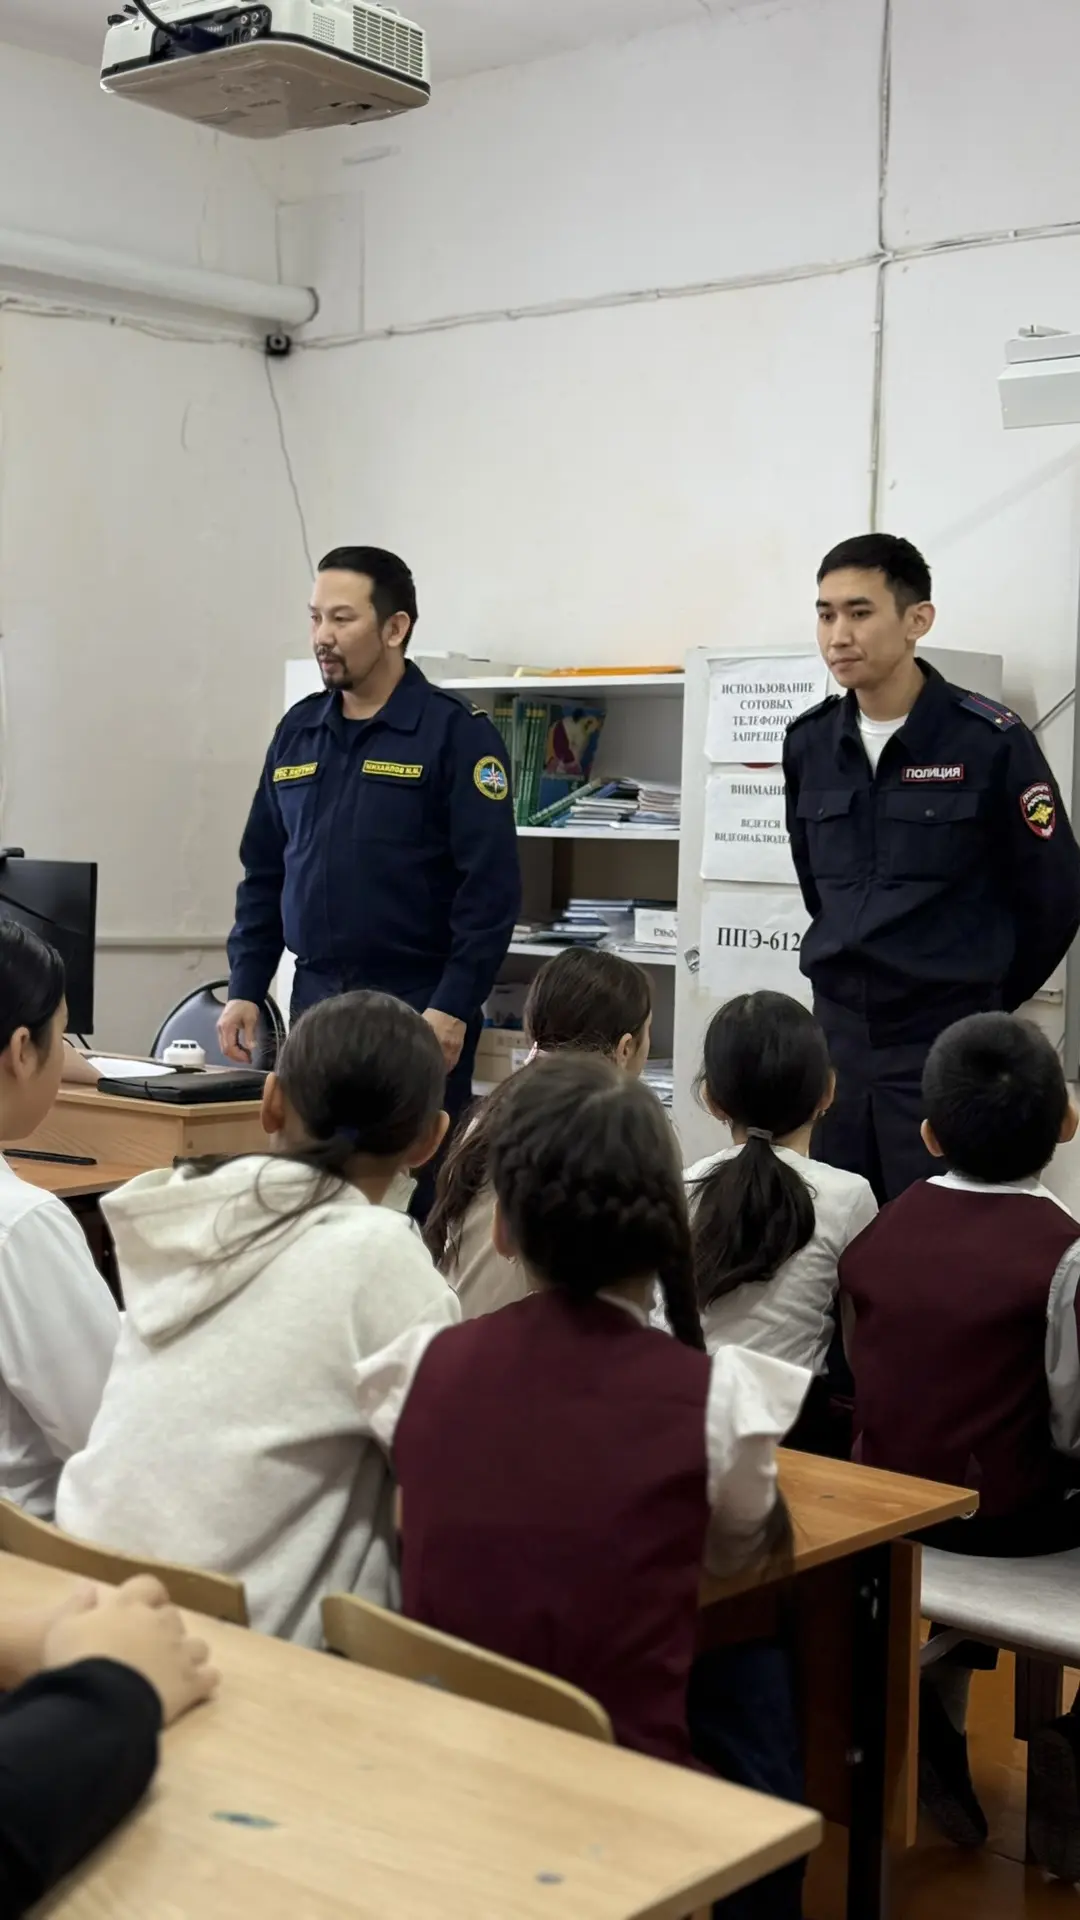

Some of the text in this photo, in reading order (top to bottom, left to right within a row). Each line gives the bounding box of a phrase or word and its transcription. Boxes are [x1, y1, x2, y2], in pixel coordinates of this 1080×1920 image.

[721, 682, 815, 695] ИСПОЛЬЗОВАНИЕ
[740, 699, 793, 710] СОТОВЫХ
[906, 767, 961, 779] ПОЛИЦИЯ
[741, 819, 781, 828] ВЕДЕТСЯ
[717, 927, 801, 952] ППЭ-612
